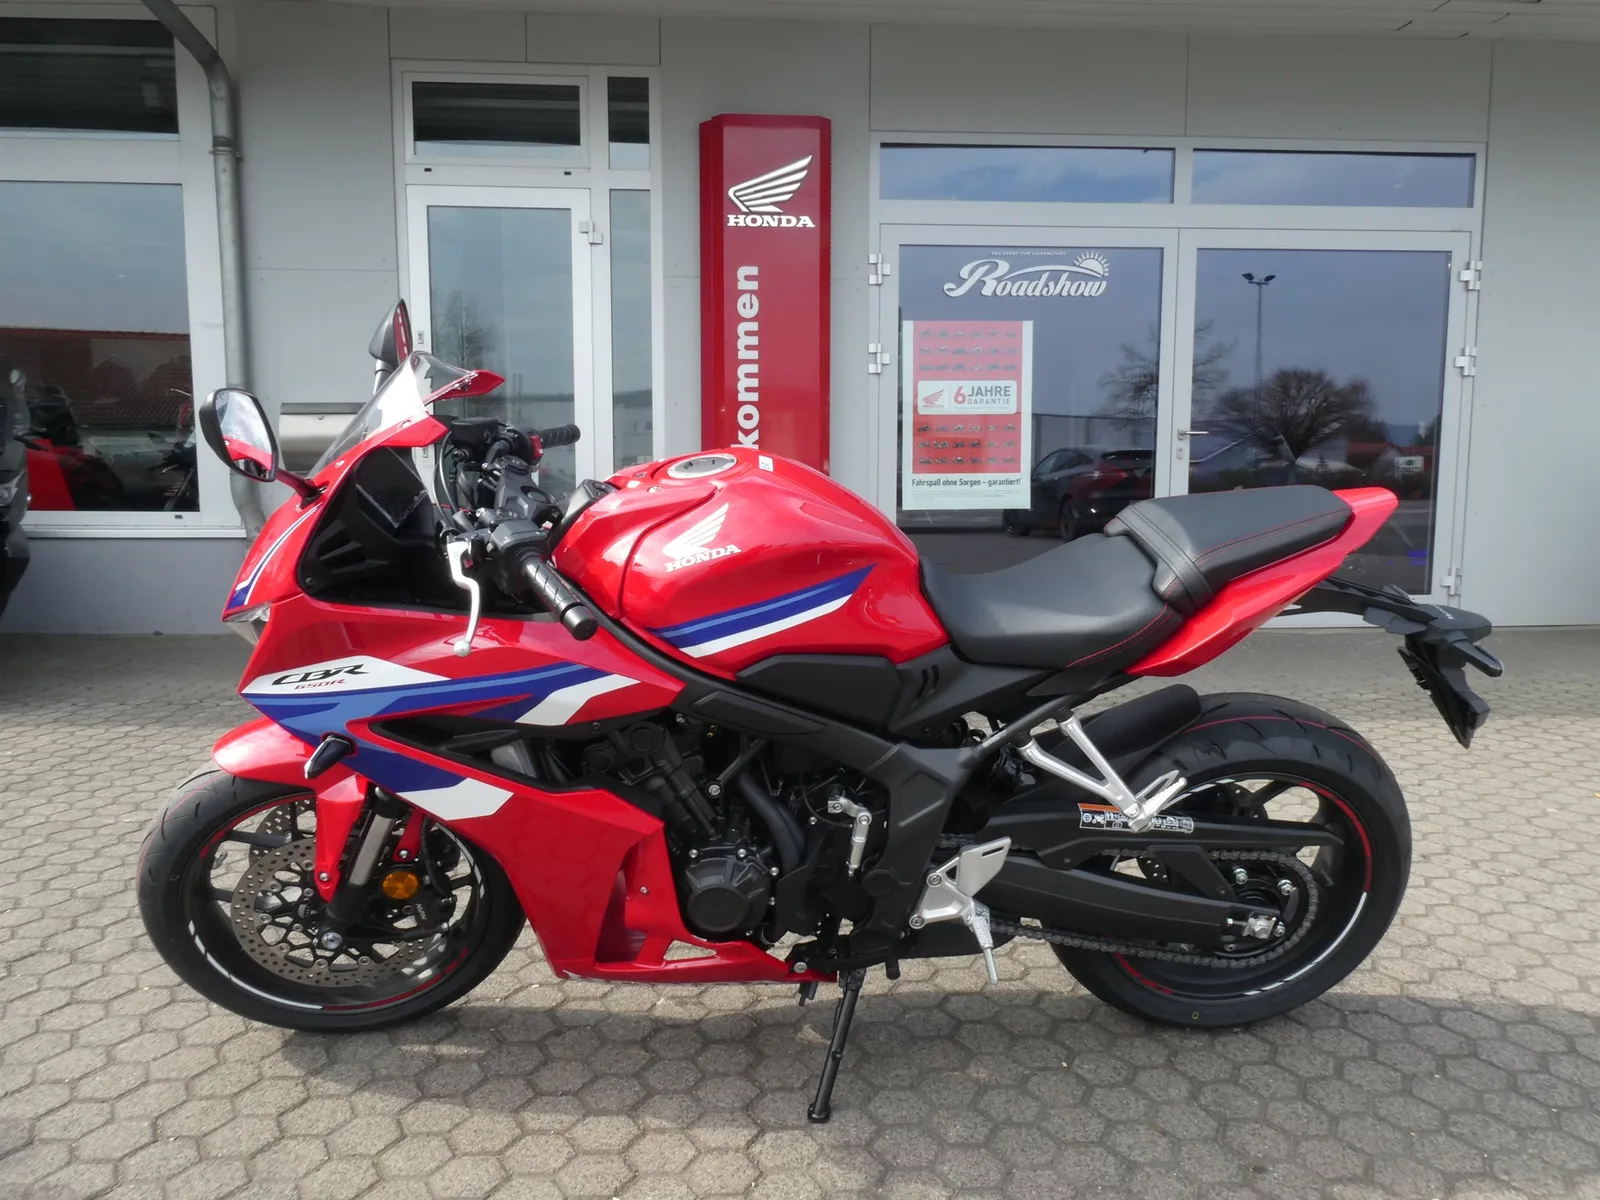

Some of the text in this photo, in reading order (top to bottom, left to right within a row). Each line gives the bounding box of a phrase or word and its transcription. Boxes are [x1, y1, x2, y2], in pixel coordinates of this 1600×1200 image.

[727, 214, 815, 228] HONDA
[943, 259, 1107, 297] Roadshow
[954, 386, 1011, 404] 6 JAHRE
[912, 478, 941, 488] Fahrspaß
[959, 478, 981, 488] Sorgen
[988, 478, 1021, 488] garantiert!
[664, 544, 742, 573] HONDA
[272, 664, 370, 686] CBR
